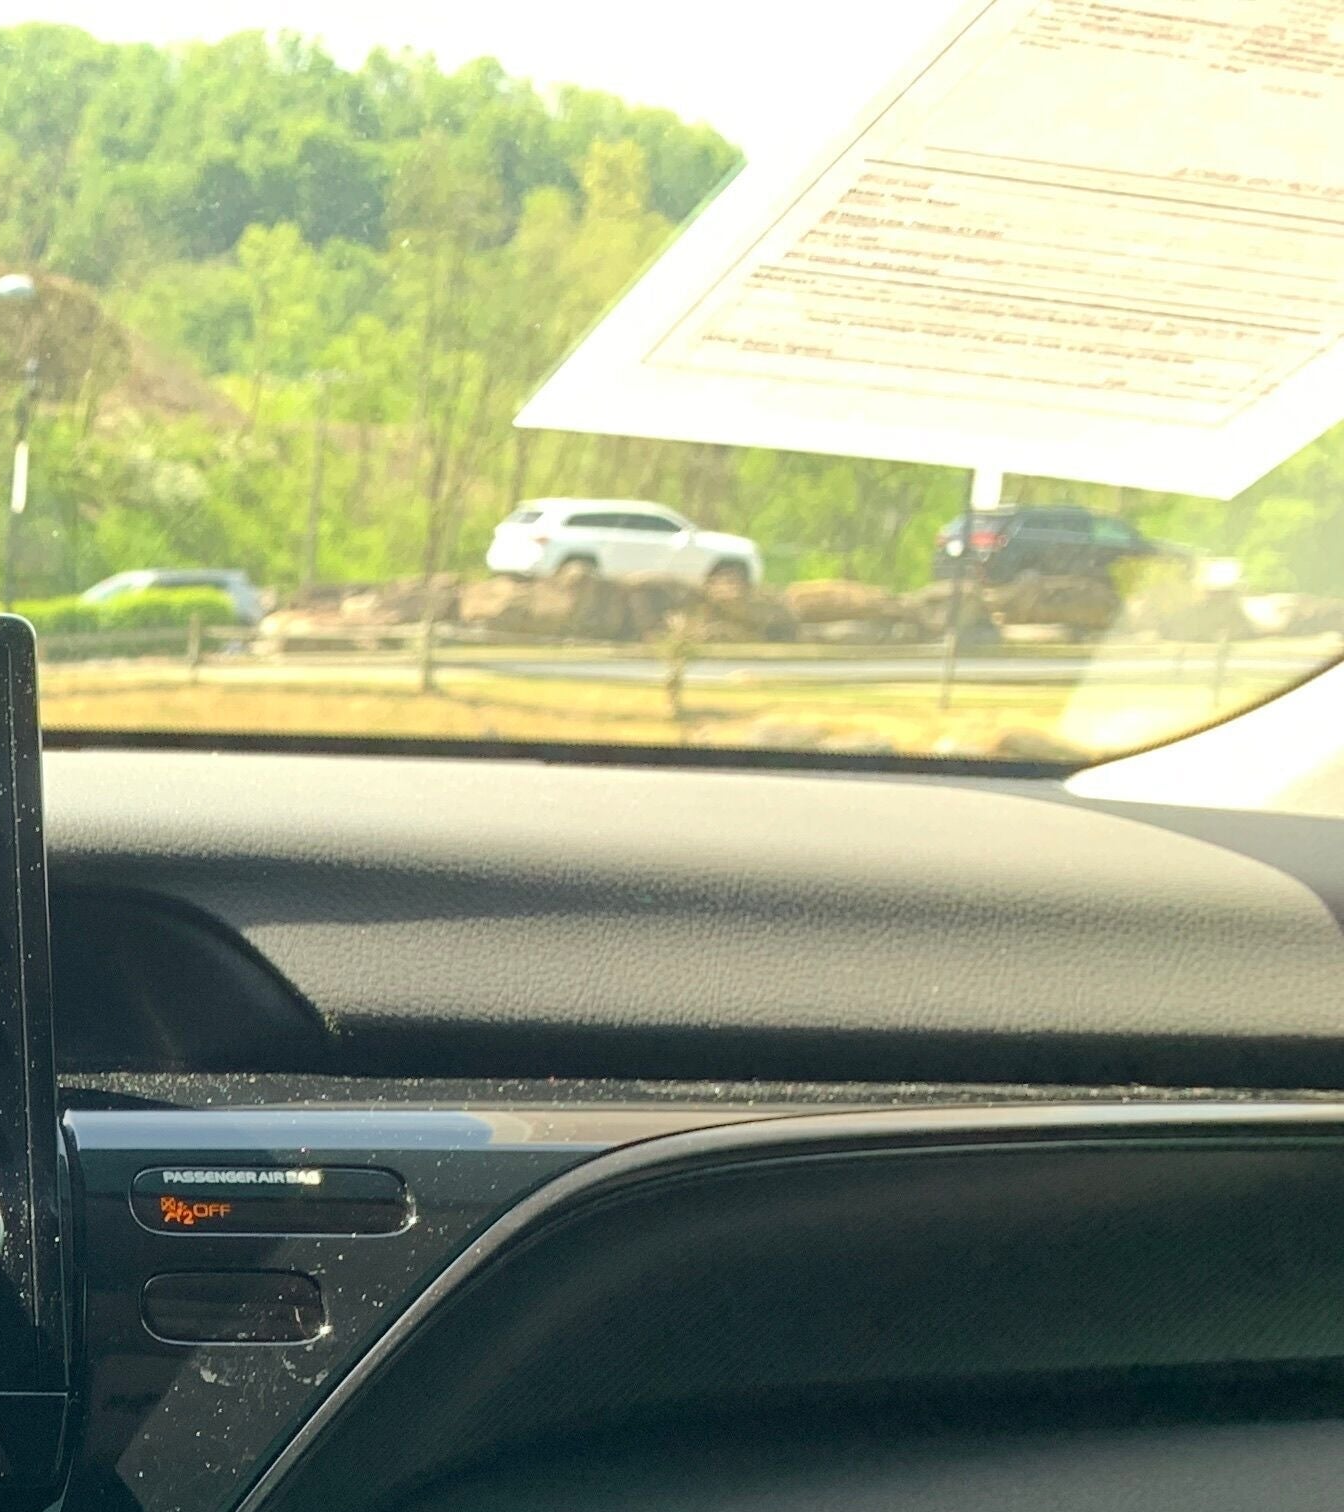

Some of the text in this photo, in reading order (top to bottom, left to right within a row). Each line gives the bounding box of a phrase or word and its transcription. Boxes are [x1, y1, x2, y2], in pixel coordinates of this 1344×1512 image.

[162, 1169, 258, 1184] PASSENGER
[258, 1169, 285, 1184] AIR
[192, 1203, 232, 1219] OFF
